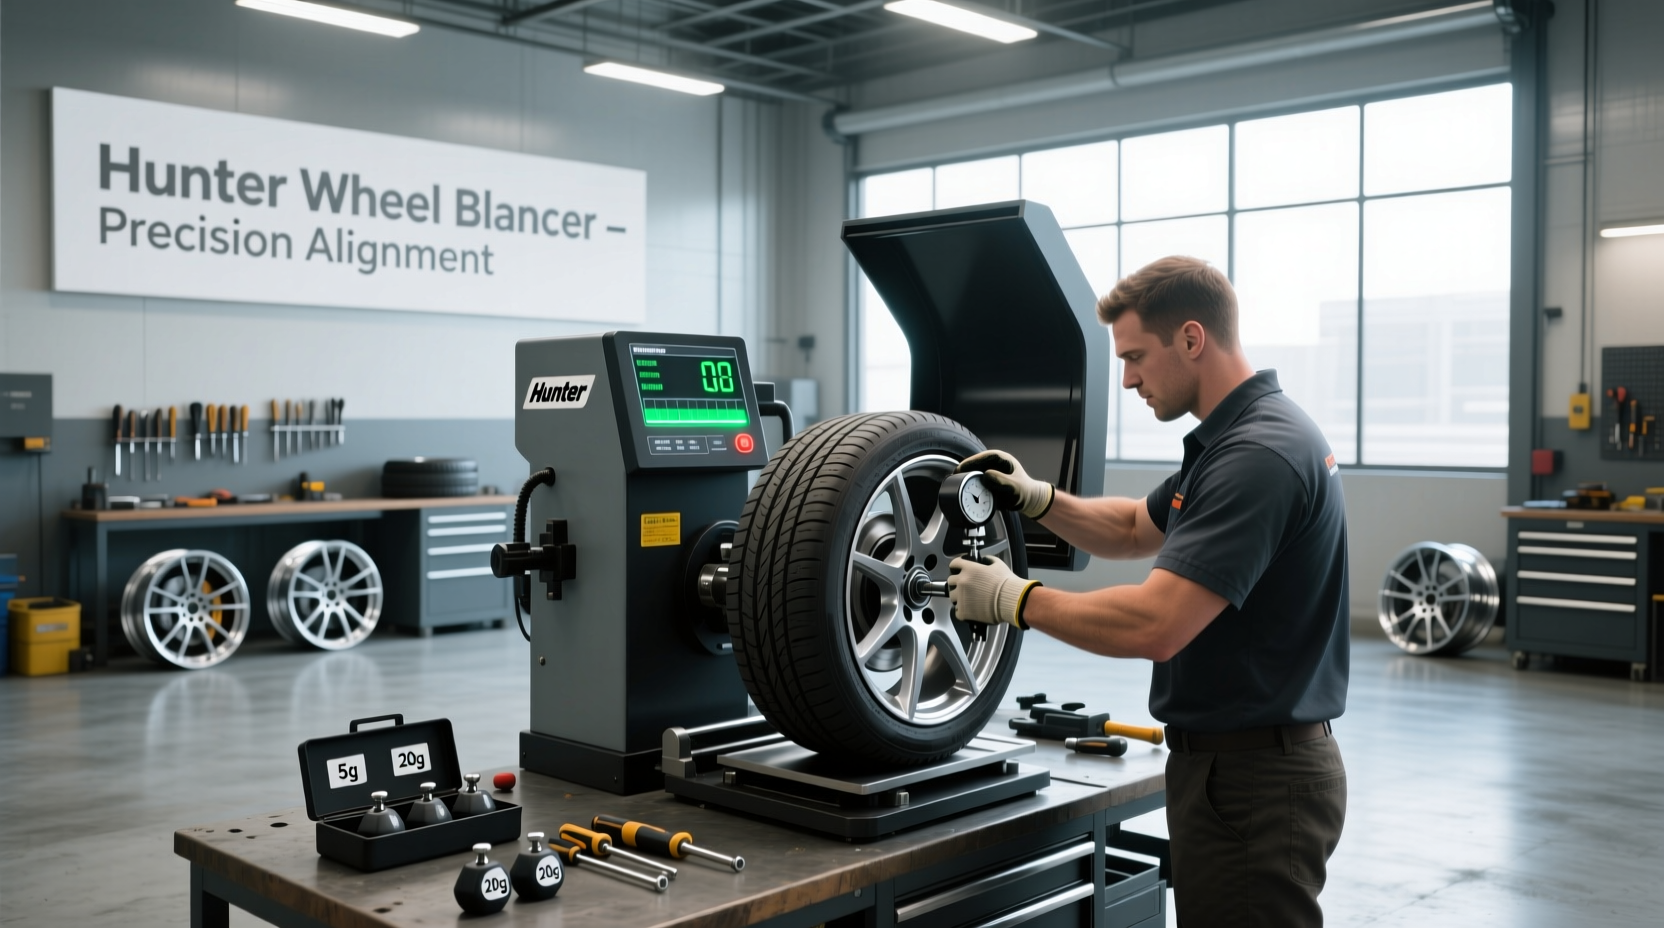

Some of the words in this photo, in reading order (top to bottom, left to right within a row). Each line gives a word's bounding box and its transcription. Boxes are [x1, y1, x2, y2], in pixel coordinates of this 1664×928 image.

[98, 142, 288, 208] Hunter
[299, 167, 441, 225] Wheel
[456, 188, 597, 240] Blancer
[99, 206, 293, 260] Precision
[305, 227, 495, 275] Alignment
[701, 361, 734, 393] 08
[529, 381, 588, 403] Hunter
[398, 751, 425, 770] 20g
[338, 763, 359, 782] 5g
[538, 864, 560, 881] 20g
[484, 877, 508, 894] 20g
